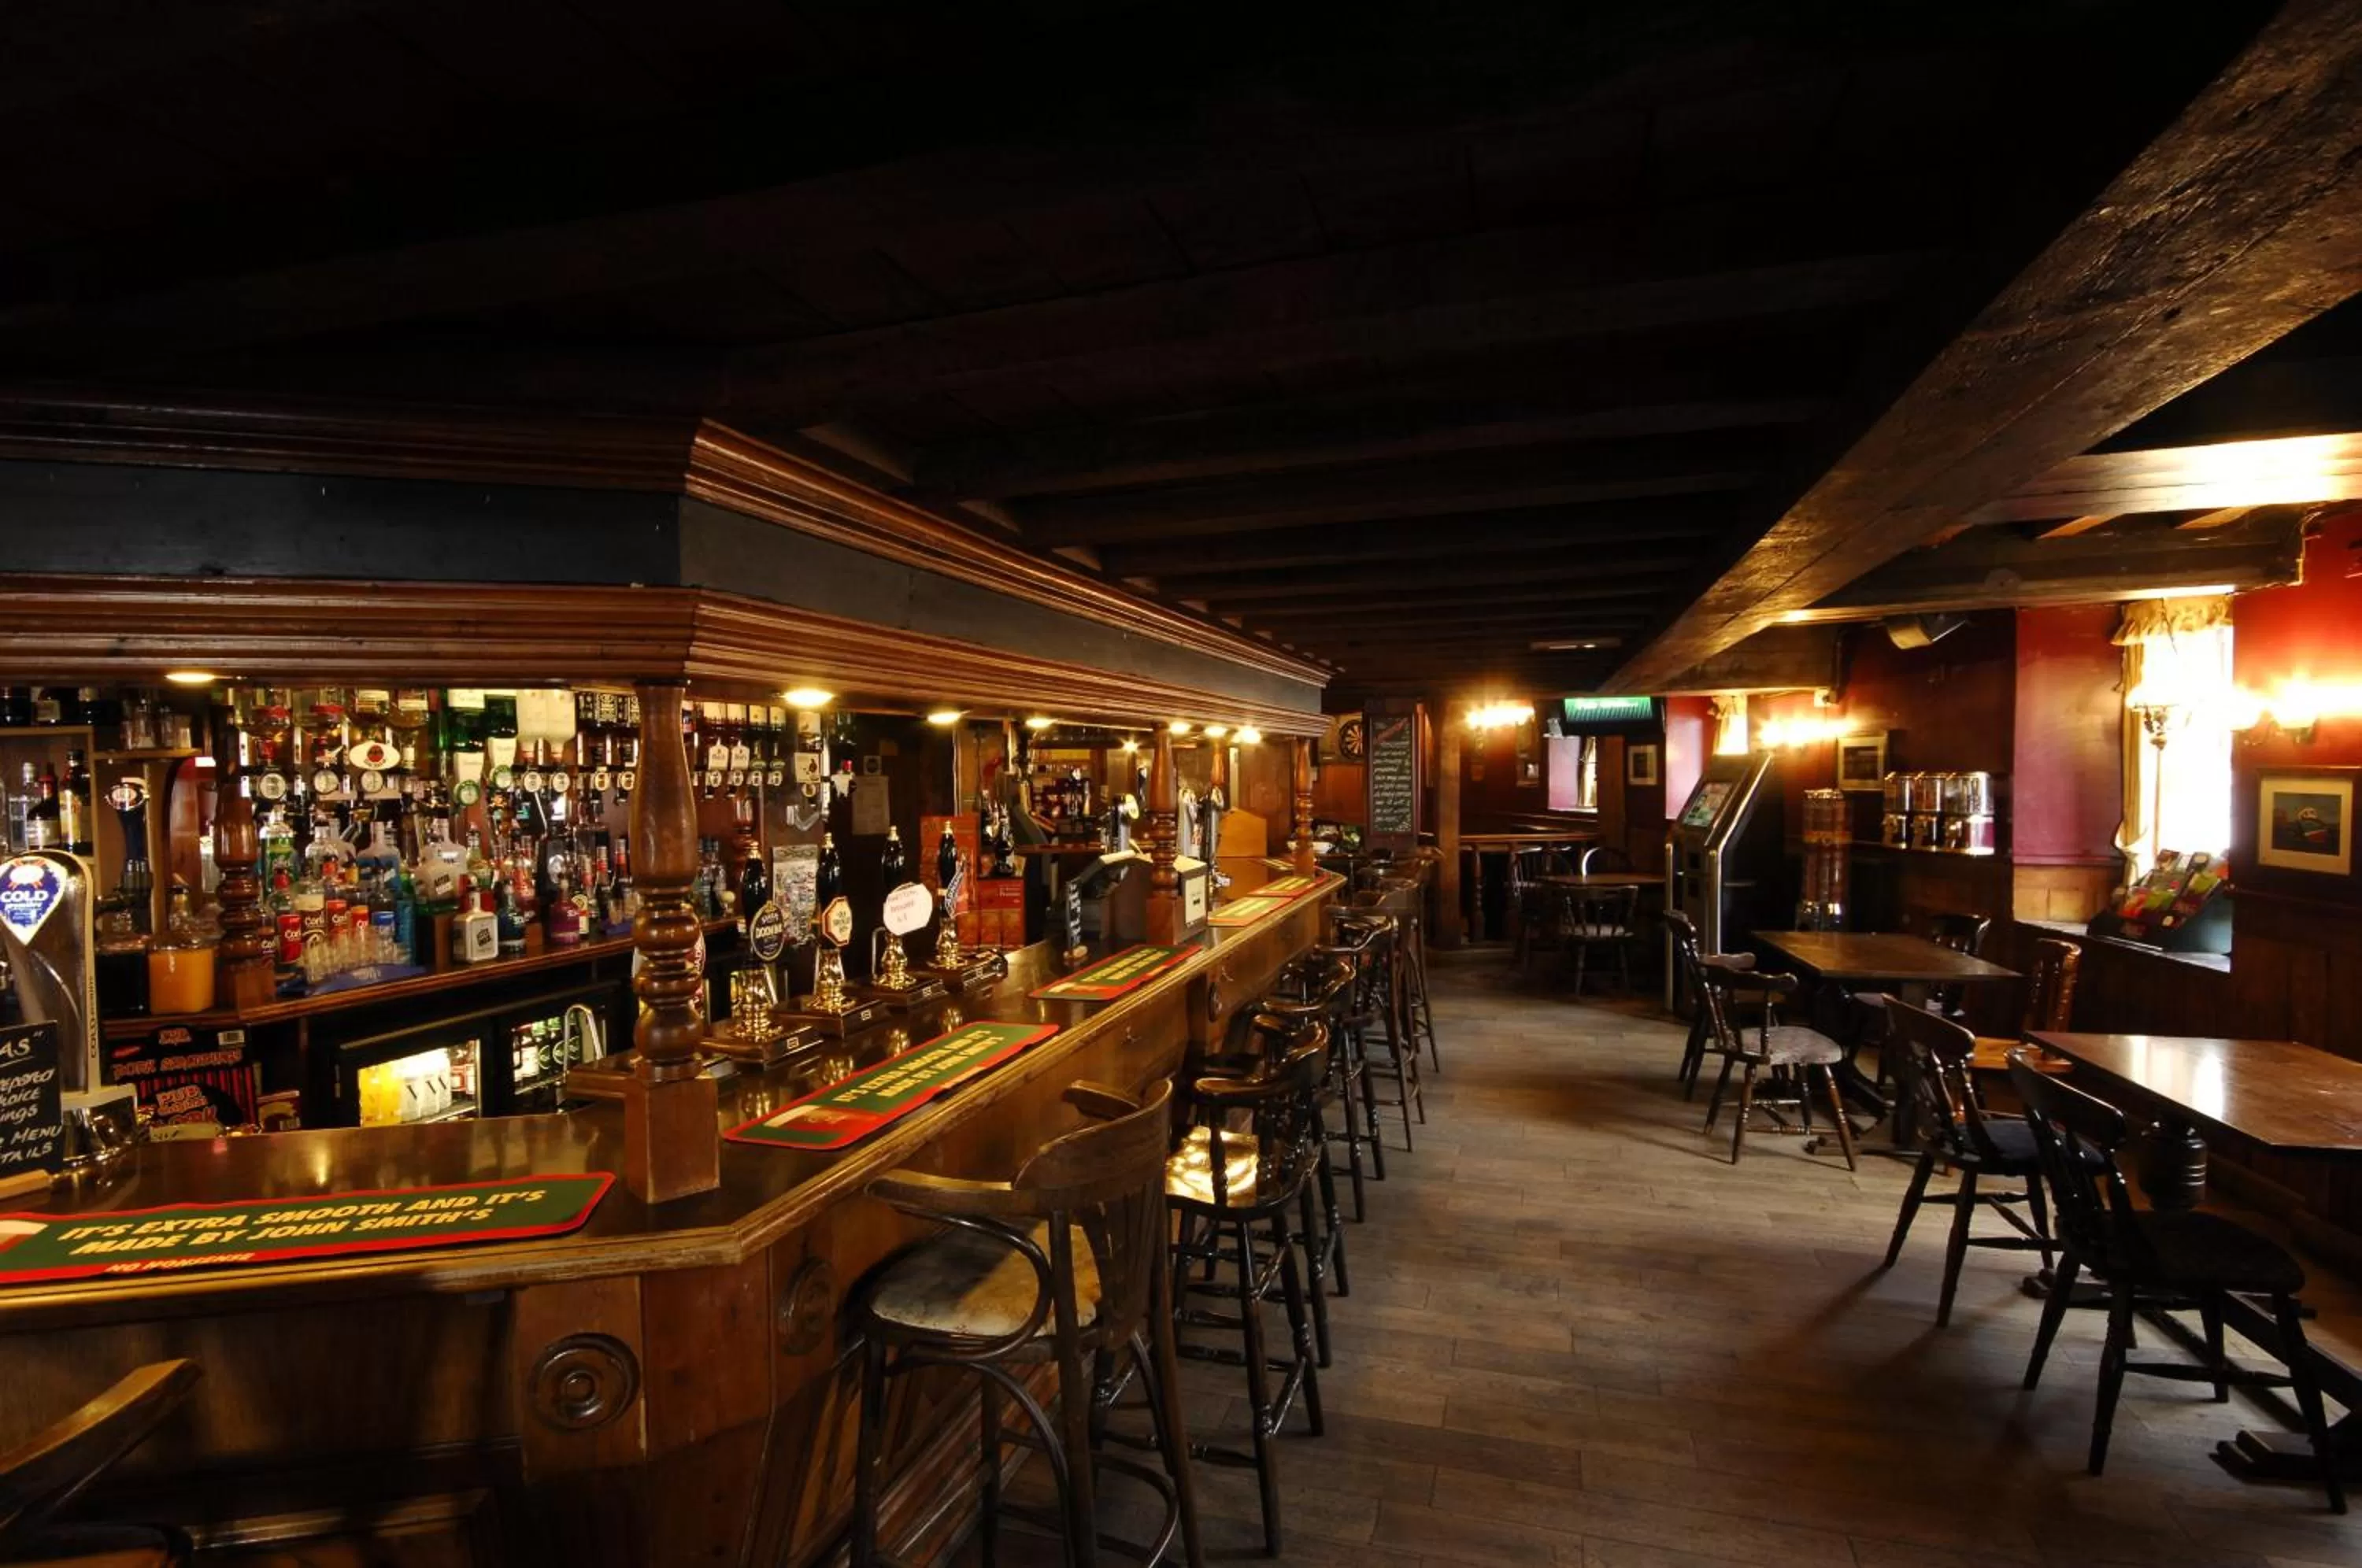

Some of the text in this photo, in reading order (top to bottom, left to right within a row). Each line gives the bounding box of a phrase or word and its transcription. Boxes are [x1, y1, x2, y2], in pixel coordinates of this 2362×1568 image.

[1, 890, 49, 903] COLD
[10, 1125, 62, 1145] MENU
[57, 1190, 546, 1241] IT'S EXTRA SMOOTH AND IT'S
[69, 1208, 494, 1255] MADE BY JOHN SMITH'S
